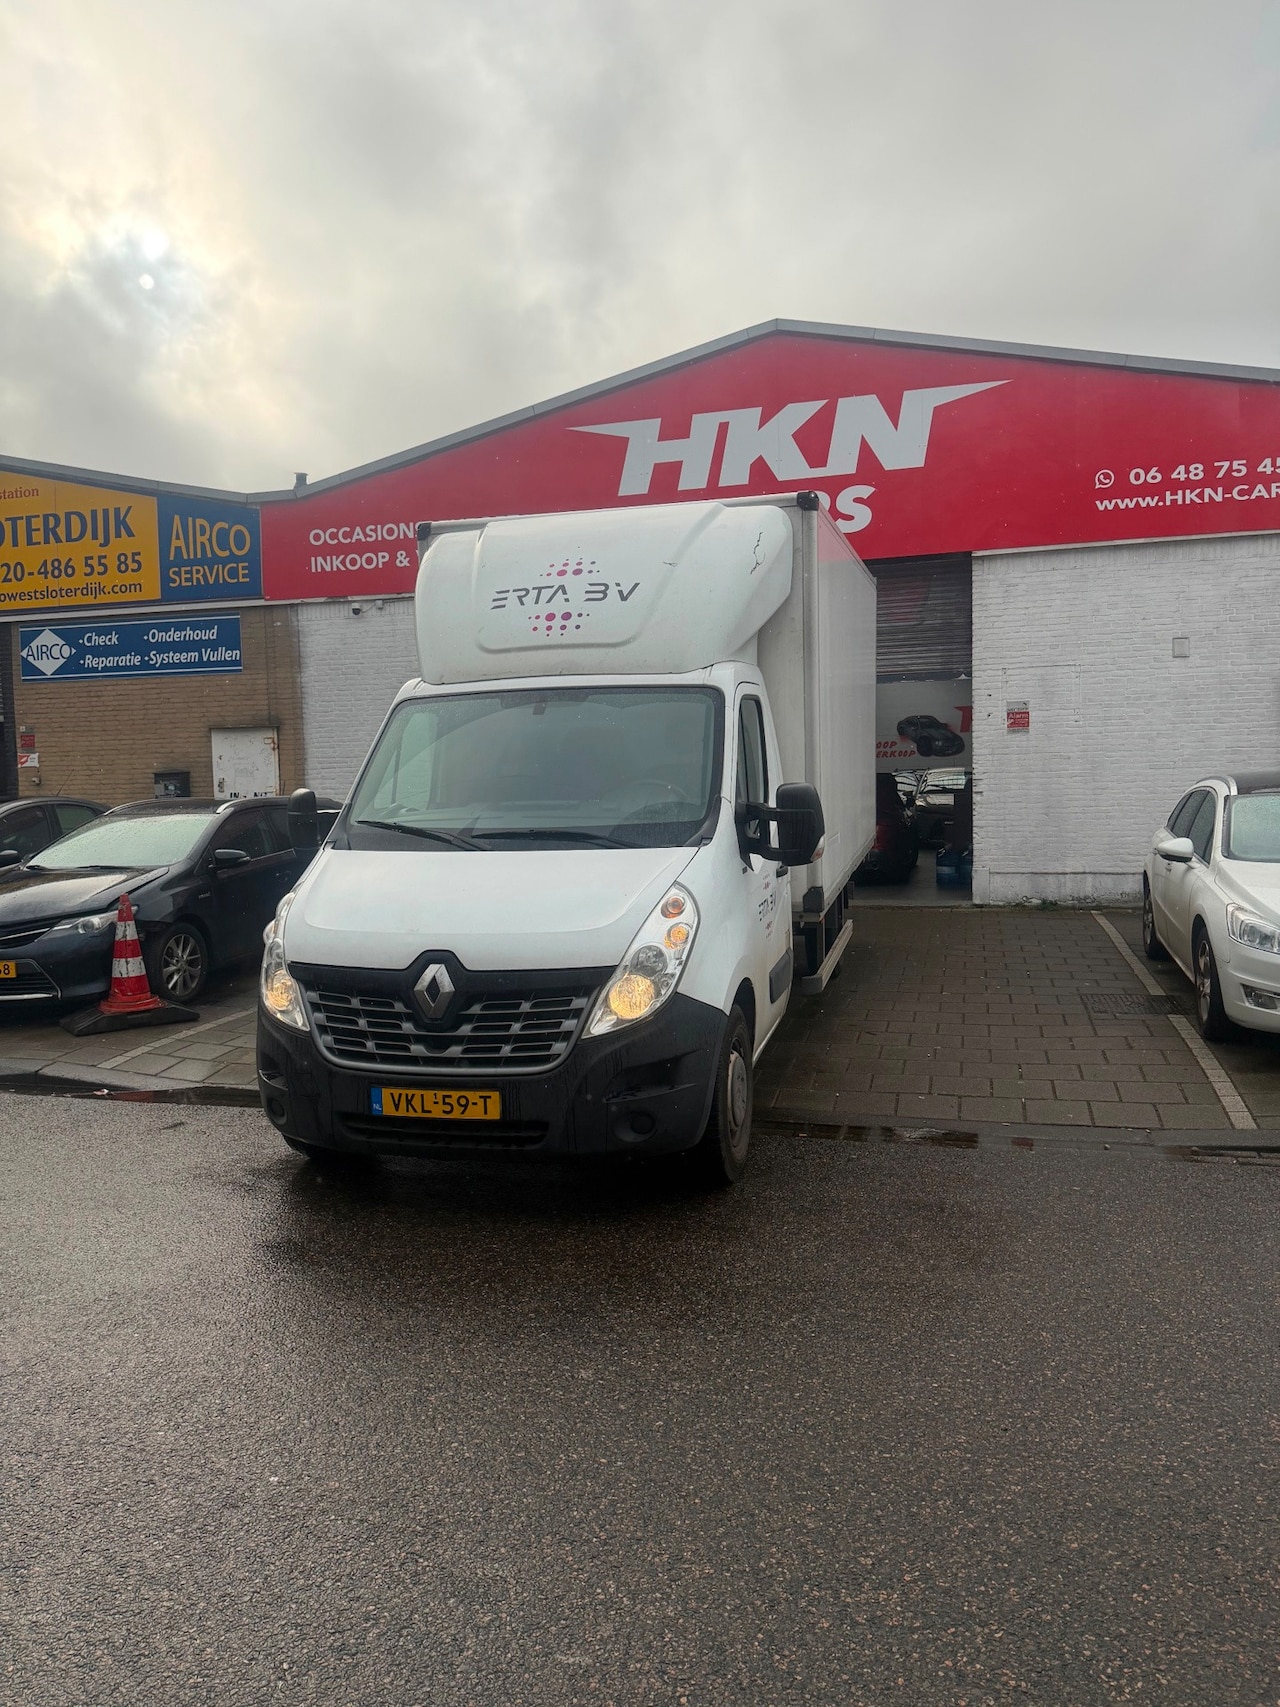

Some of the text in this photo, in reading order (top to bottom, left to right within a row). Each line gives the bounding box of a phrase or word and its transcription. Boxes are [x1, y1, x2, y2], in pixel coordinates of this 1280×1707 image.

[564, 379, 1014, 496] HKN
[1129, 467, 1162, 485] 06
[1170, 463, 1204, 481] 48
[1213, 459, 1247, 478] 75
[0, 506, 136, 548] TERDIJK
[169, 514, 250, 561] AIRCO
[309, 522, 418, 546] OCCASION
[83, 554, 109, 578] 55
[116, 551, 142, 574] 85
[310, 550, 410, 573] INKOOP &
[169, 562, 249, 588] SERVICE
[490, 582, 641, 610] ERTA BV
[83, 631, 119, 647] Check
[148, 625, 218, 643] Onderhoud
[26, 643, 72, 662] AIRCO
[84, 652, 141, 671] Reparatie
[149, 646, 240, 668] Systeem Vullen
[390, 1092, 492, 1115] VKL-59-T
